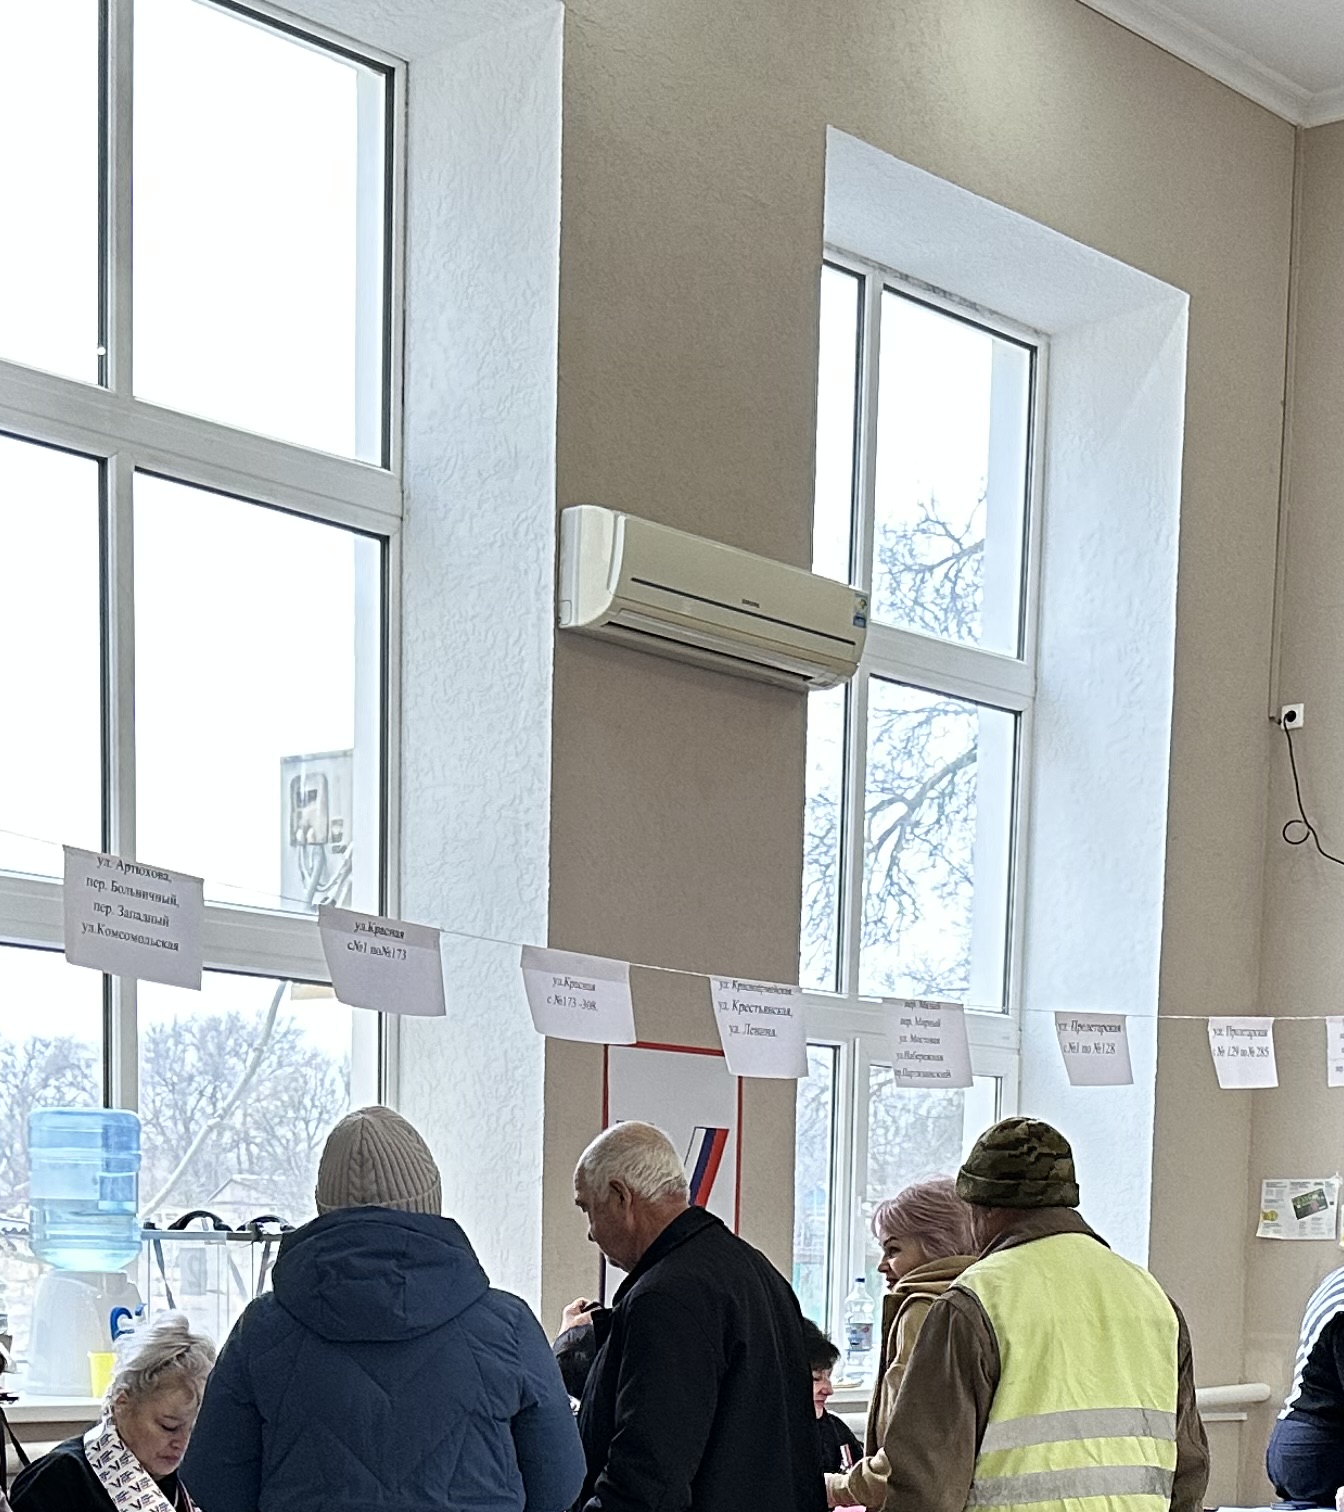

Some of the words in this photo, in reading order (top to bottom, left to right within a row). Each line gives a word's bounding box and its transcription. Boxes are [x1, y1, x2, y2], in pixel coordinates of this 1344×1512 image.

[96, 856, 112, 869] ул.
[86, 876, 108, 892] пер.
[93, 902, 114, 917] пер.
[117, 905, 170, 928] Западный
